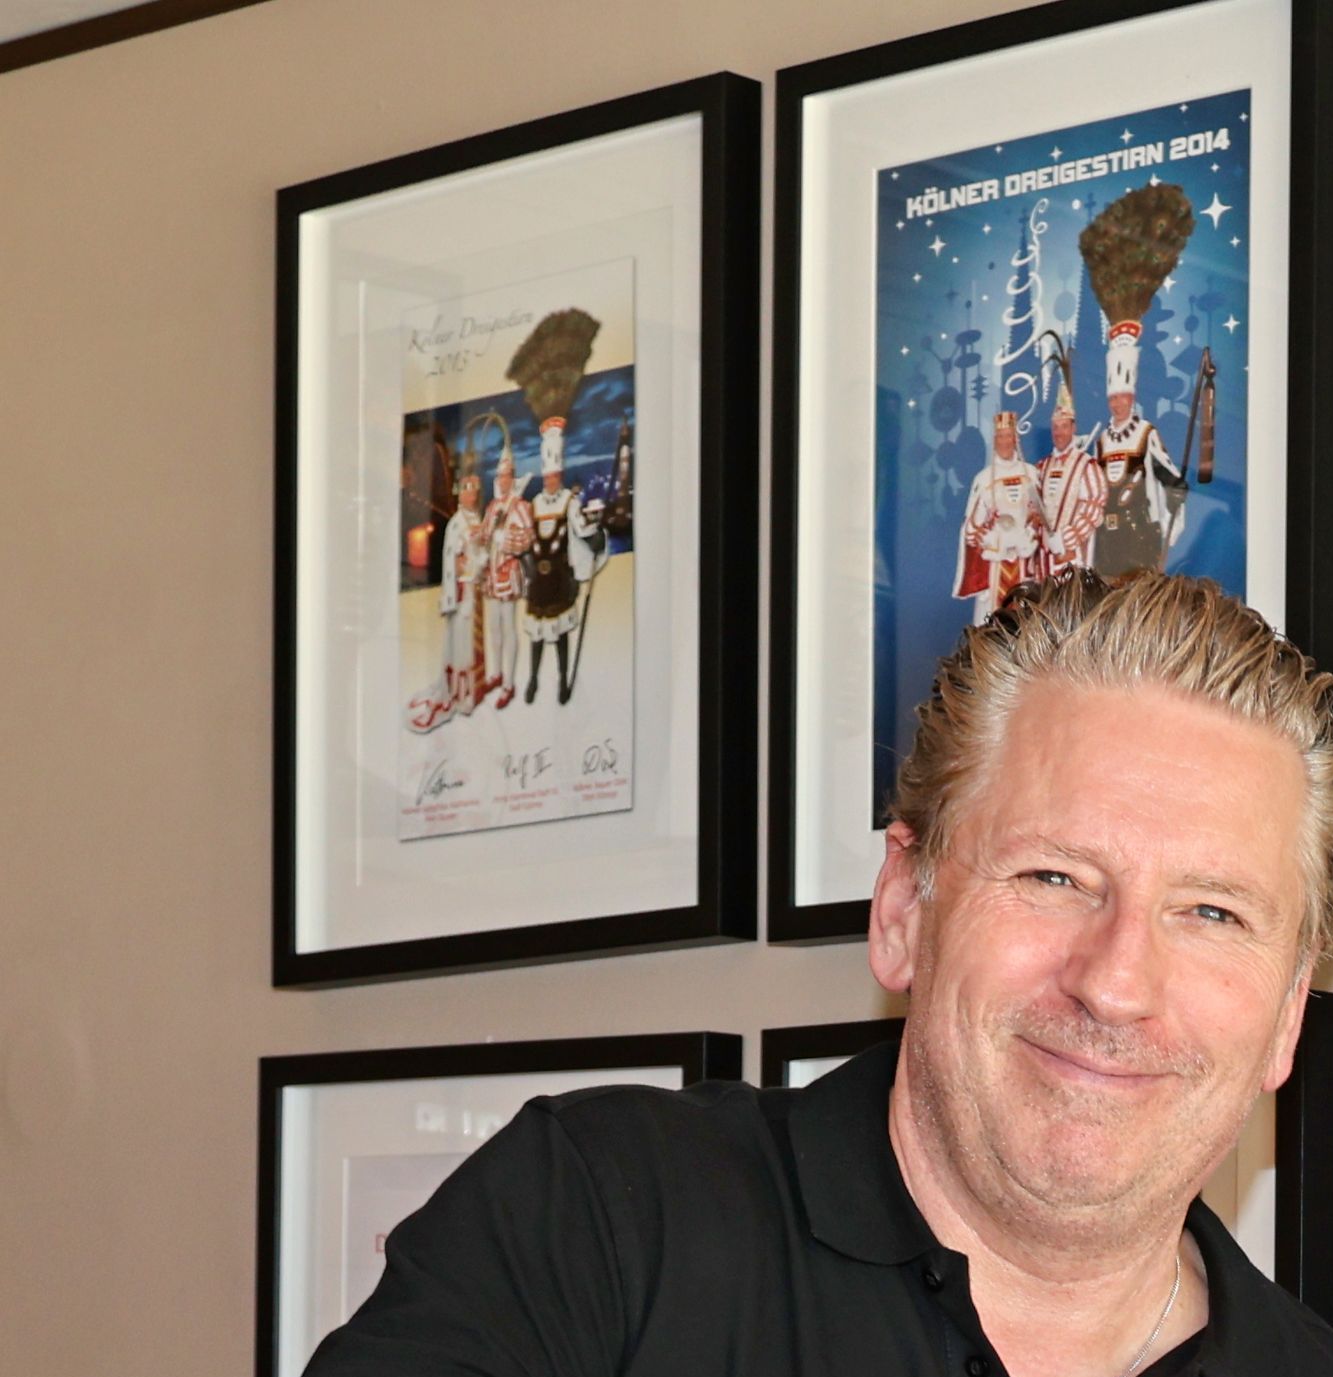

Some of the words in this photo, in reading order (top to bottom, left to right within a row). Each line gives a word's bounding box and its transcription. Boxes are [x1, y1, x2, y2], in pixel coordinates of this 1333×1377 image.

[906, 178, 999, 219] KÖLNER
[1004, 141, 1164, 198] DREIGESTIRN
[1169, 128, 1231, 162] 2014
